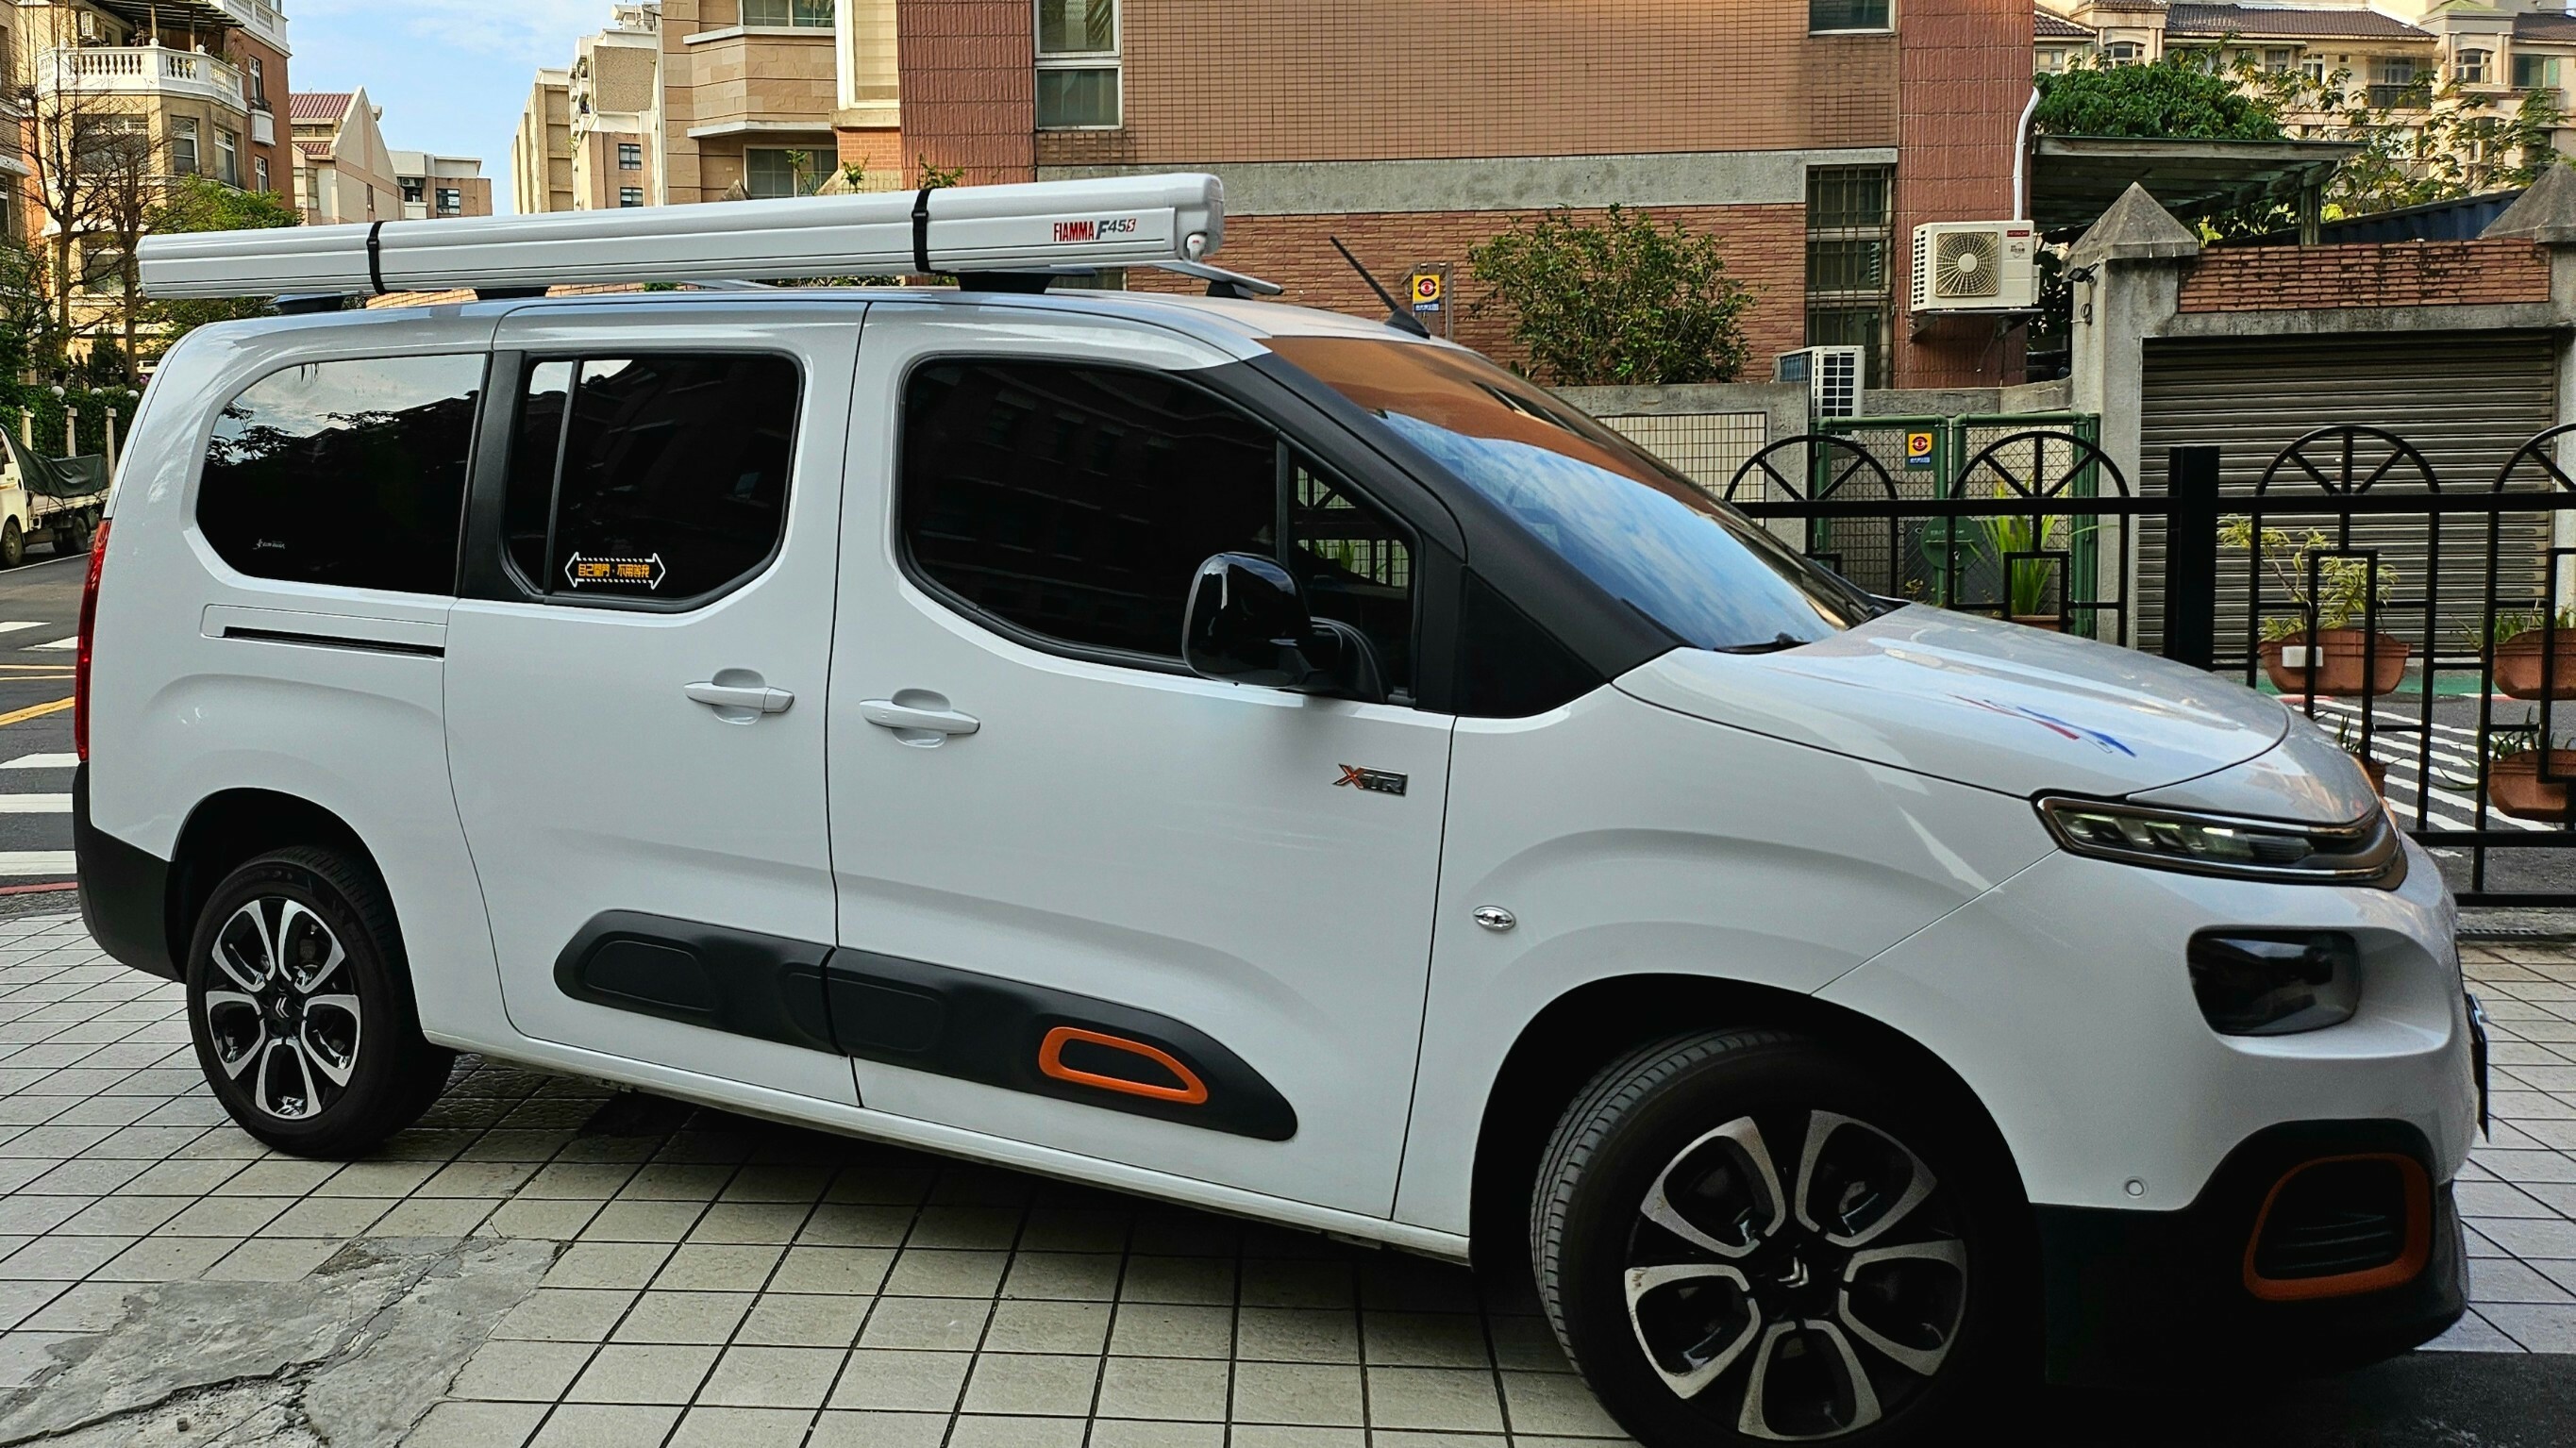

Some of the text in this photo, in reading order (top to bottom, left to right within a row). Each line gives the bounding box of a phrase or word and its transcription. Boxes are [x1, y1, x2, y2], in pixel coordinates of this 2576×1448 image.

[1053, 218, 1137, 242] FIAMMA F45S
[1332, 763, 1407, 797] XTR
